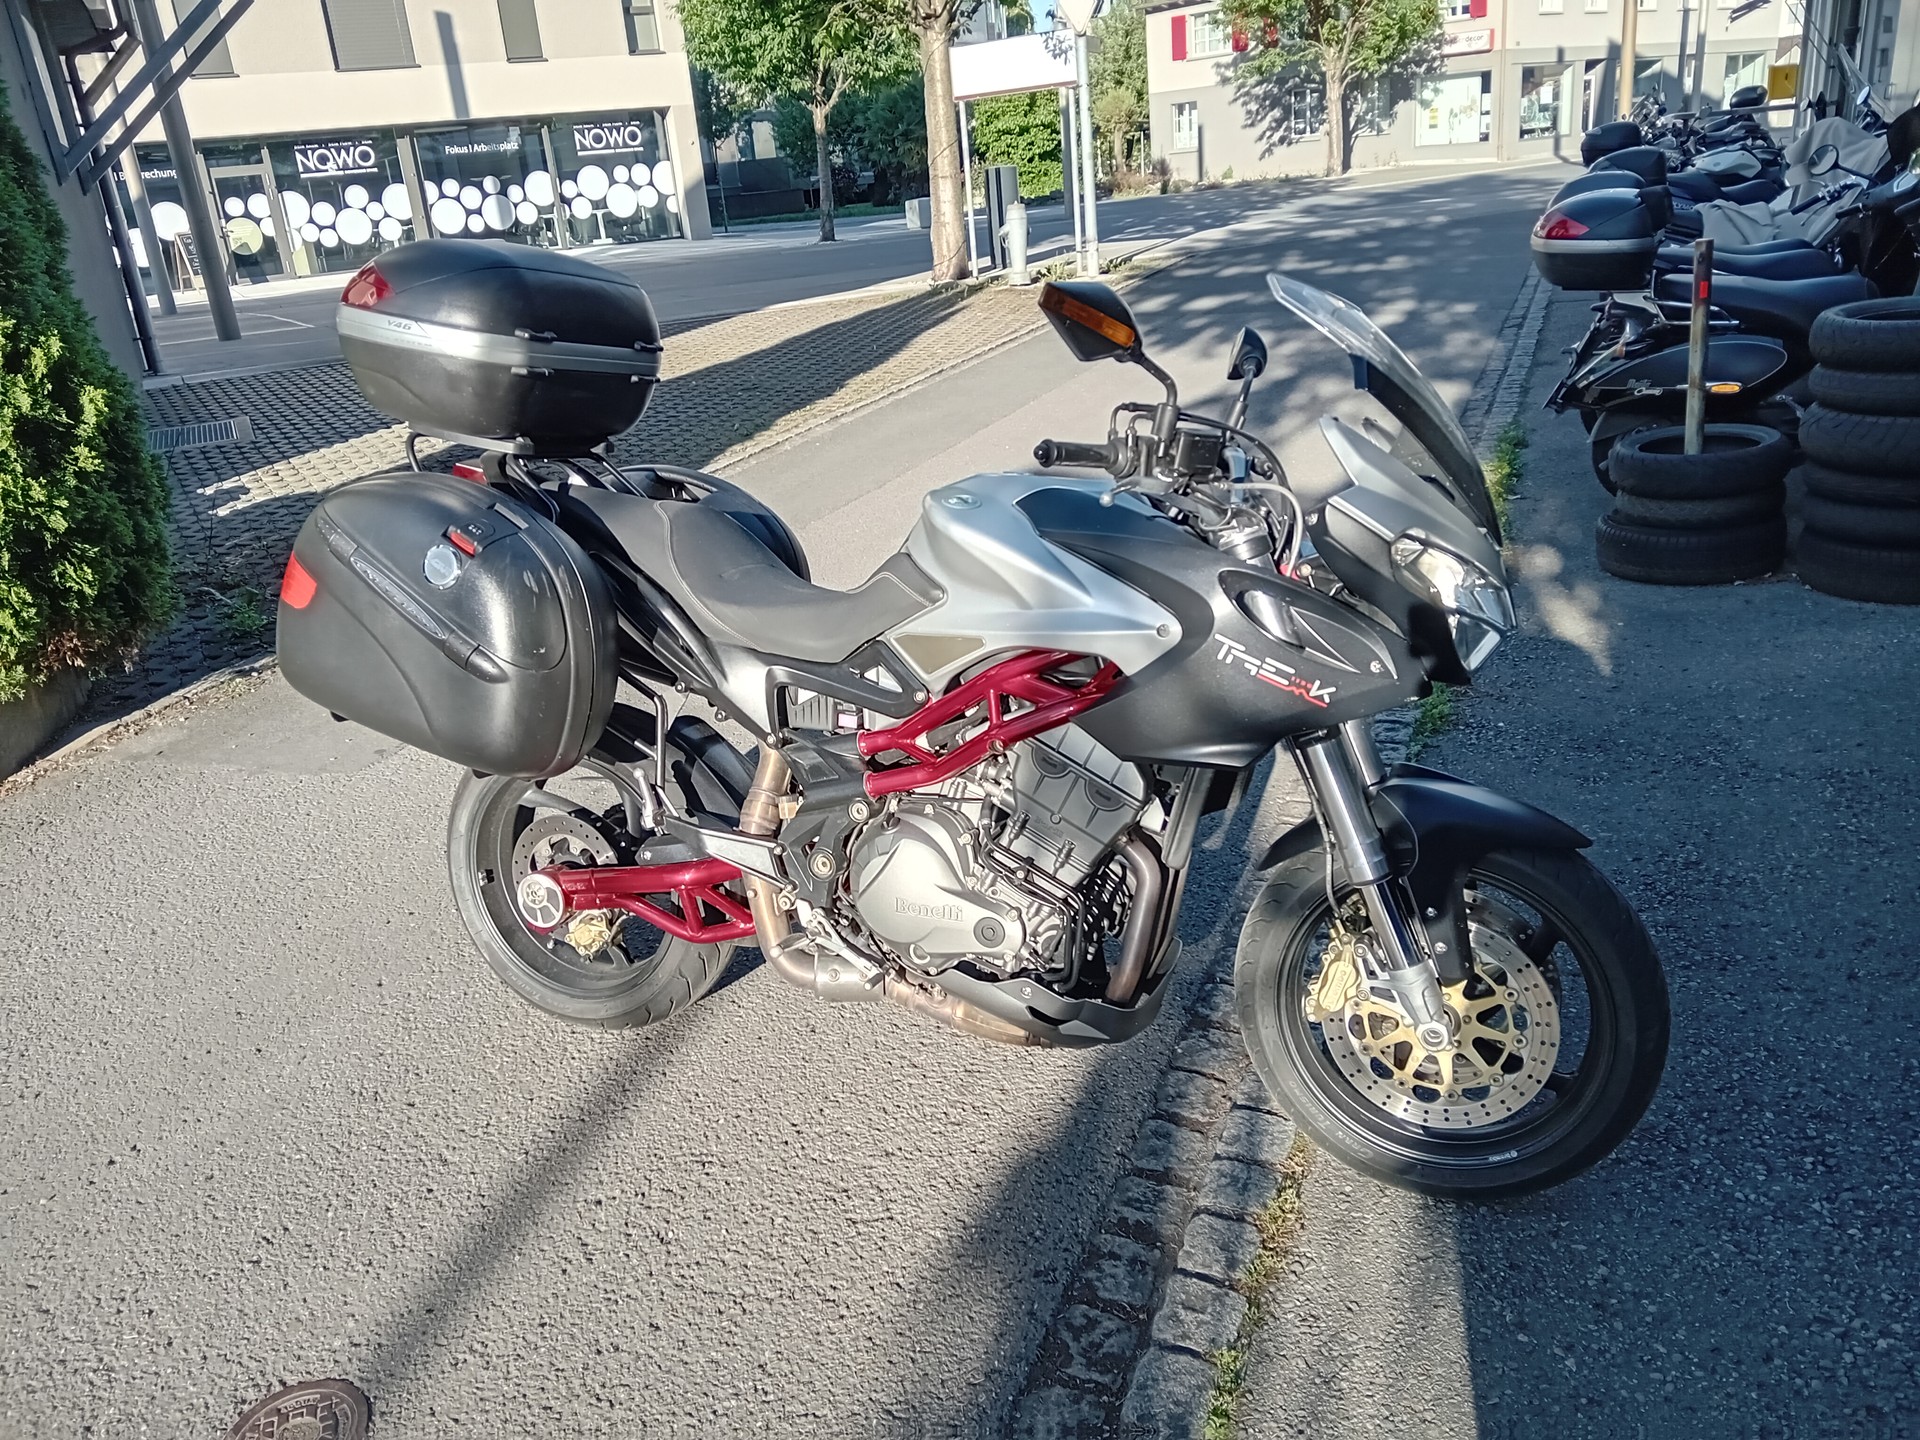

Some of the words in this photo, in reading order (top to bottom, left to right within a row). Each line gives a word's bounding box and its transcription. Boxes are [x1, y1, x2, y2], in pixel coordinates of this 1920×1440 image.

[444, 144, 468, 155] Fokus
[474, 141, 519, 153] Arbeitsplatz
[573, 126, 642, 150] NOWO
[294, 145, 375, 172] NOWO
[895, 897, 964, 922] Benelli
